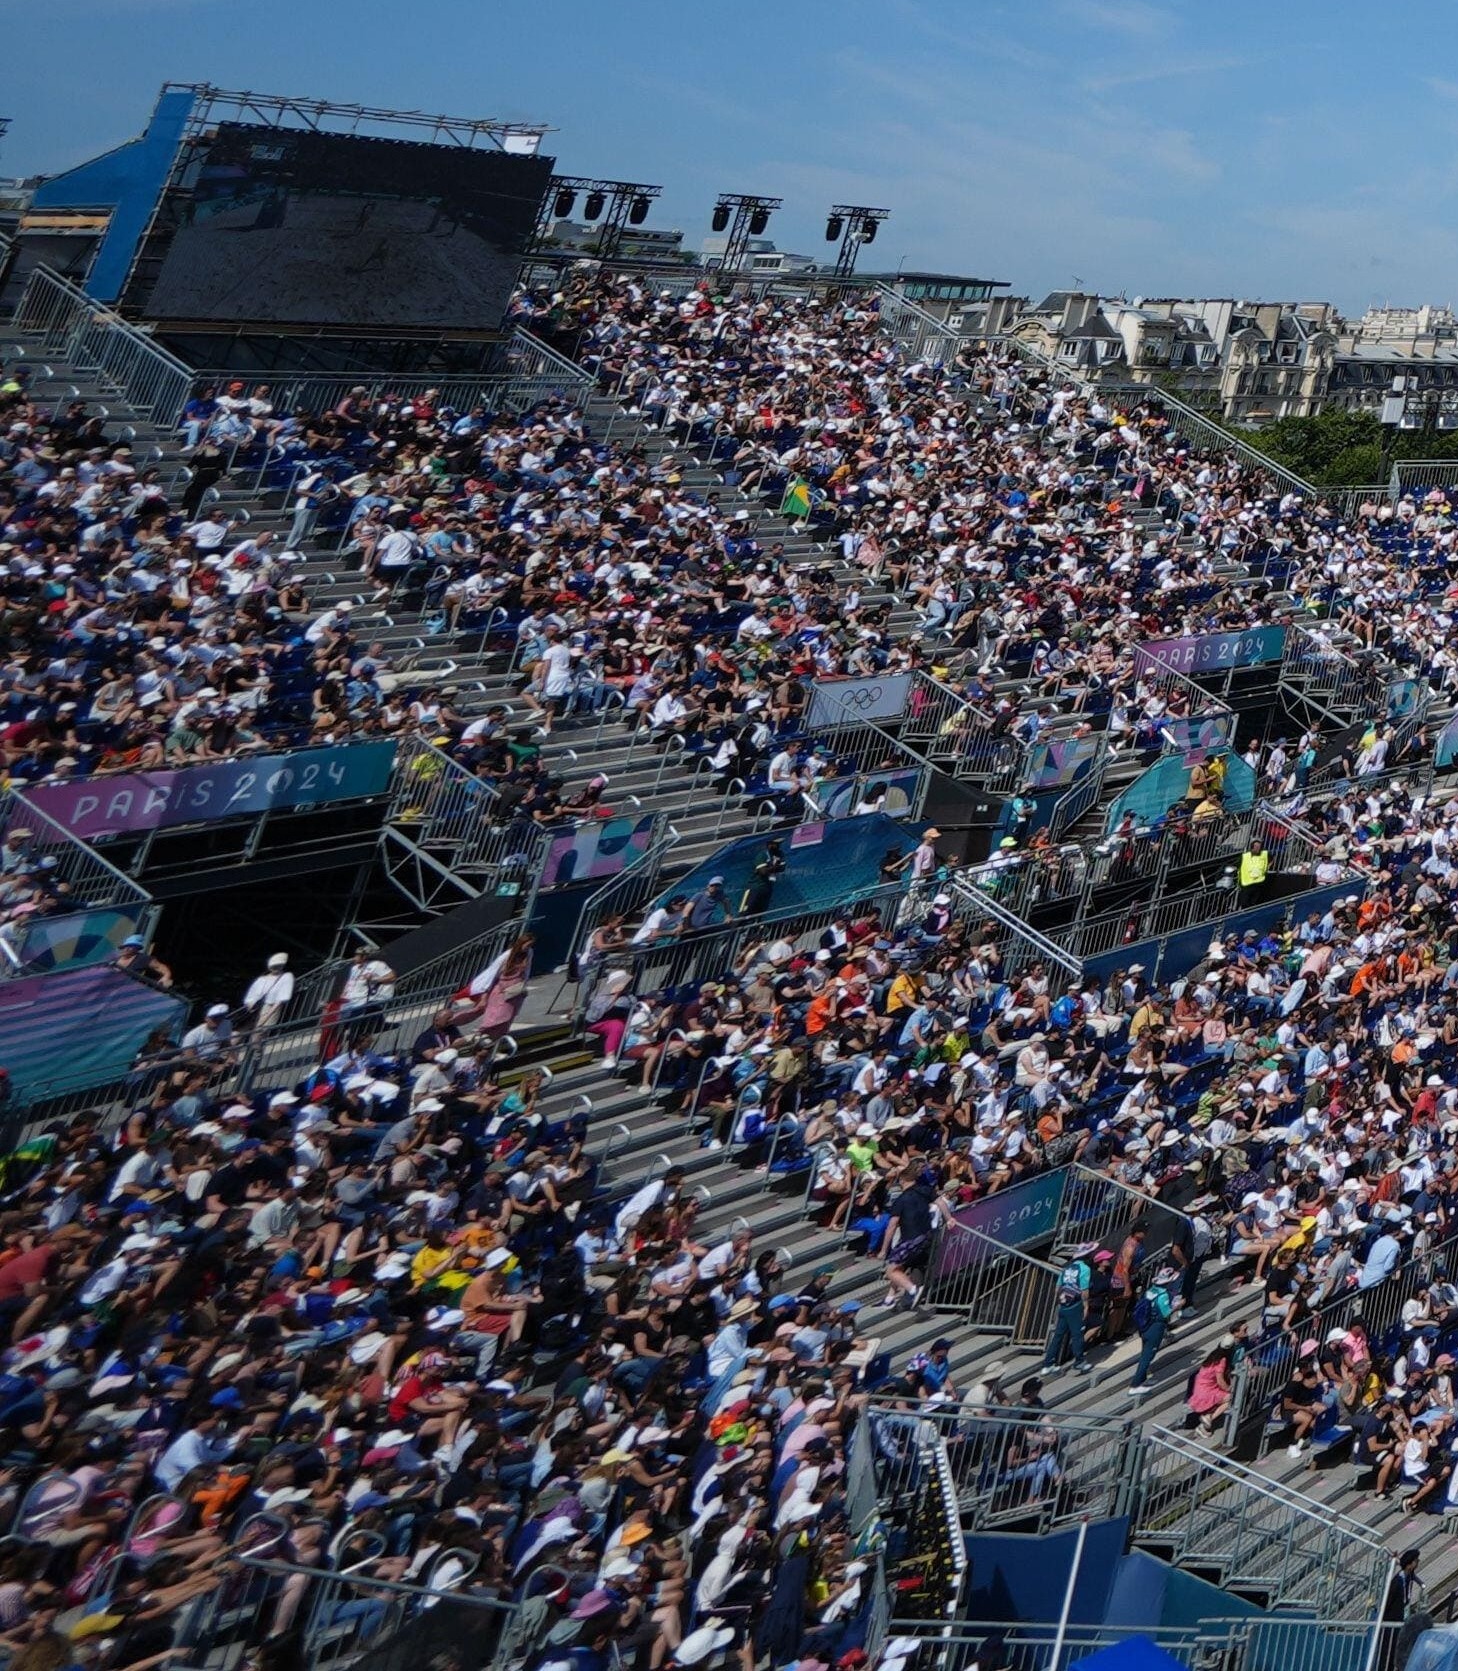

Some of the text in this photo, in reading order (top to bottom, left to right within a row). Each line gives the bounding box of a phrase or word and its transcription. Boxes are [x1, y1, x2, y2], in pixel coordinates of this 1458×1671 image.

[1157, 638, 1264, 666] PARIS 2024
[71, 761, 346, 825] PARIS 2024
